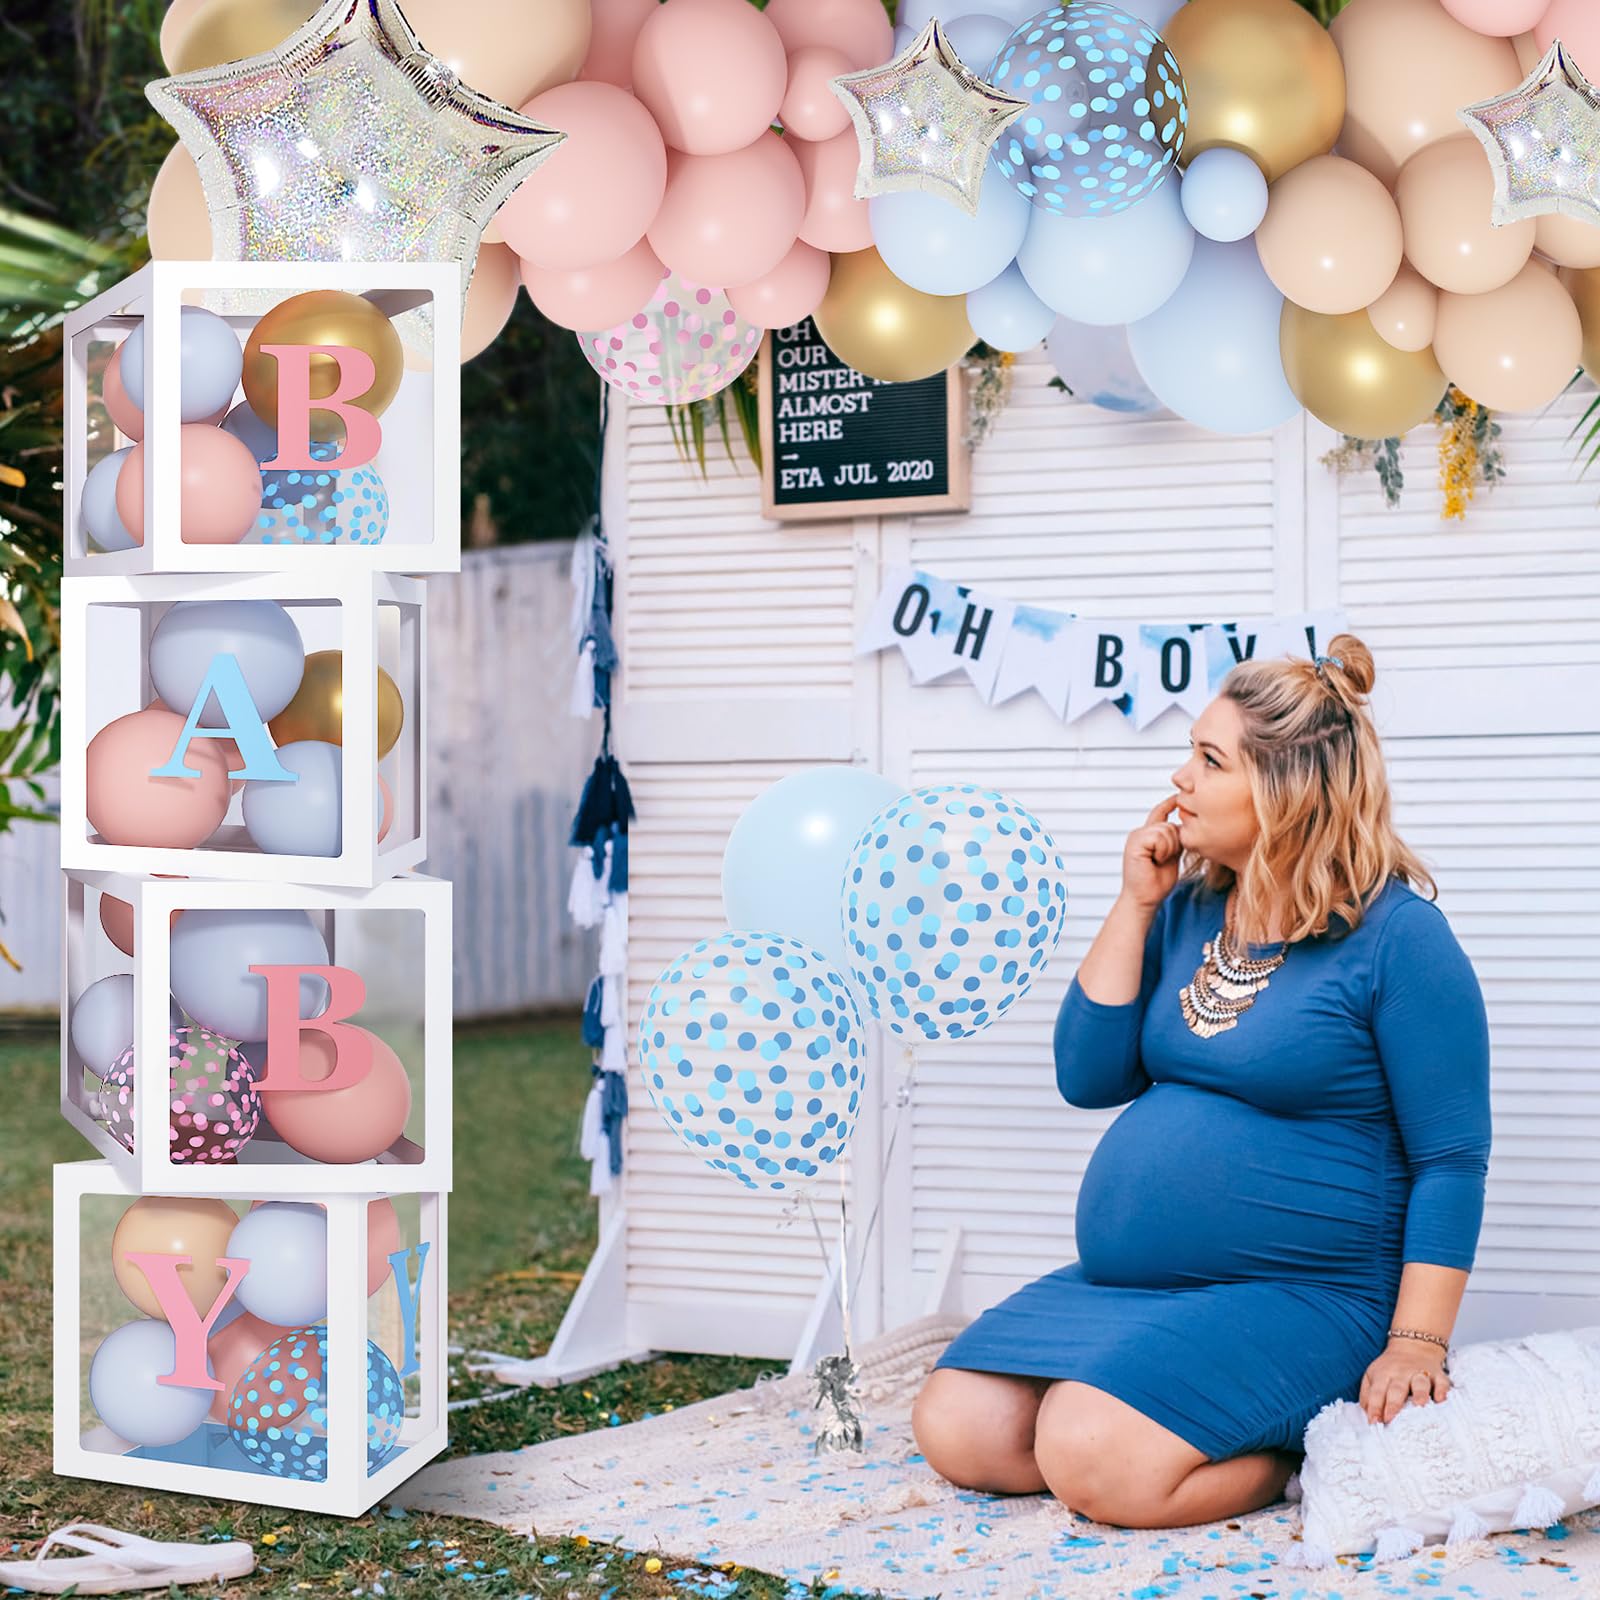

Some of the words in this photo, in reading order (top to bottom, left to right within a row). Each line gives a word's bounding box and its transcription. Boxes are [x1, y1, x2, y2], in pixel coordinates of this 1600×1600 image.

[777, 320, 811, 342] OH
[777, 345, 829, 368] OUR
[778, 368, 865, 394] MISTER
[778, 391, 873, 418] ALMOST
[779, 420, 844, 443] HERE
[780, 467, 825, 489] ETA
[834, 463, 878, 486] JUL
[887, 459, 934, 483] 2020
[892, 583, 994, 661] OH
